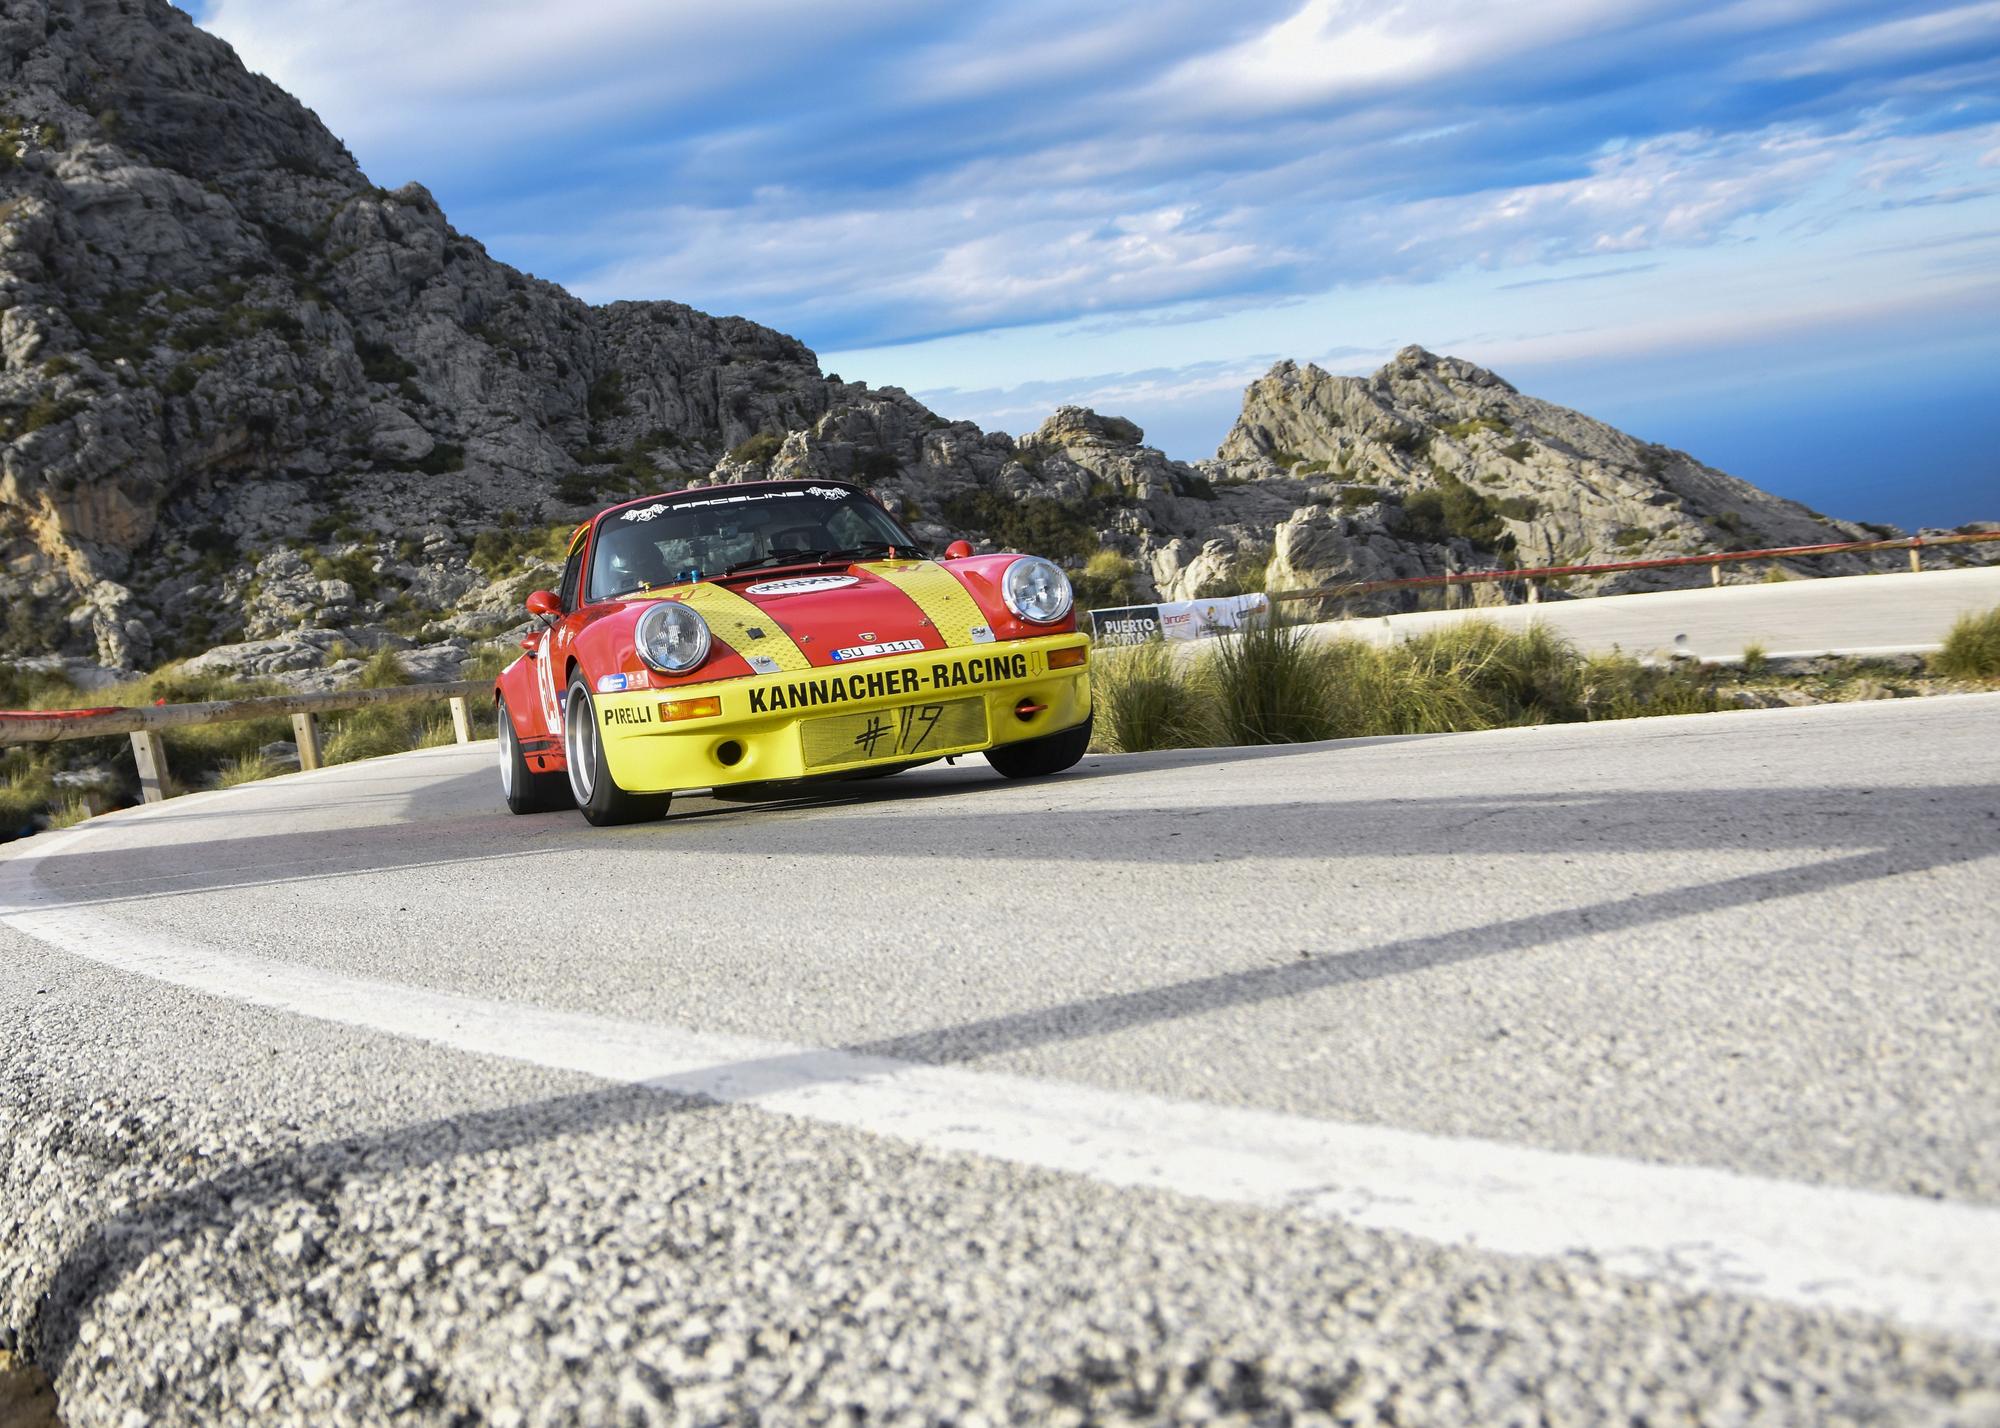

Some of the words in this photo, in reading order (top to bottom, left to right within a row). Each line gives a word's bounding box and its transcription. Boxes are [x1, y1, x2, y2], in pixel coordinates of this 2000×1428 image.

[1104, 619, 1155, 634] PUERTO
[840, 648, 864, 659] SU
[875, 640, 923, 654] J11H
[749, 653, 1027, 713] KANNACHER-RACING
[604, 706, 652, 726] PIRELLI
